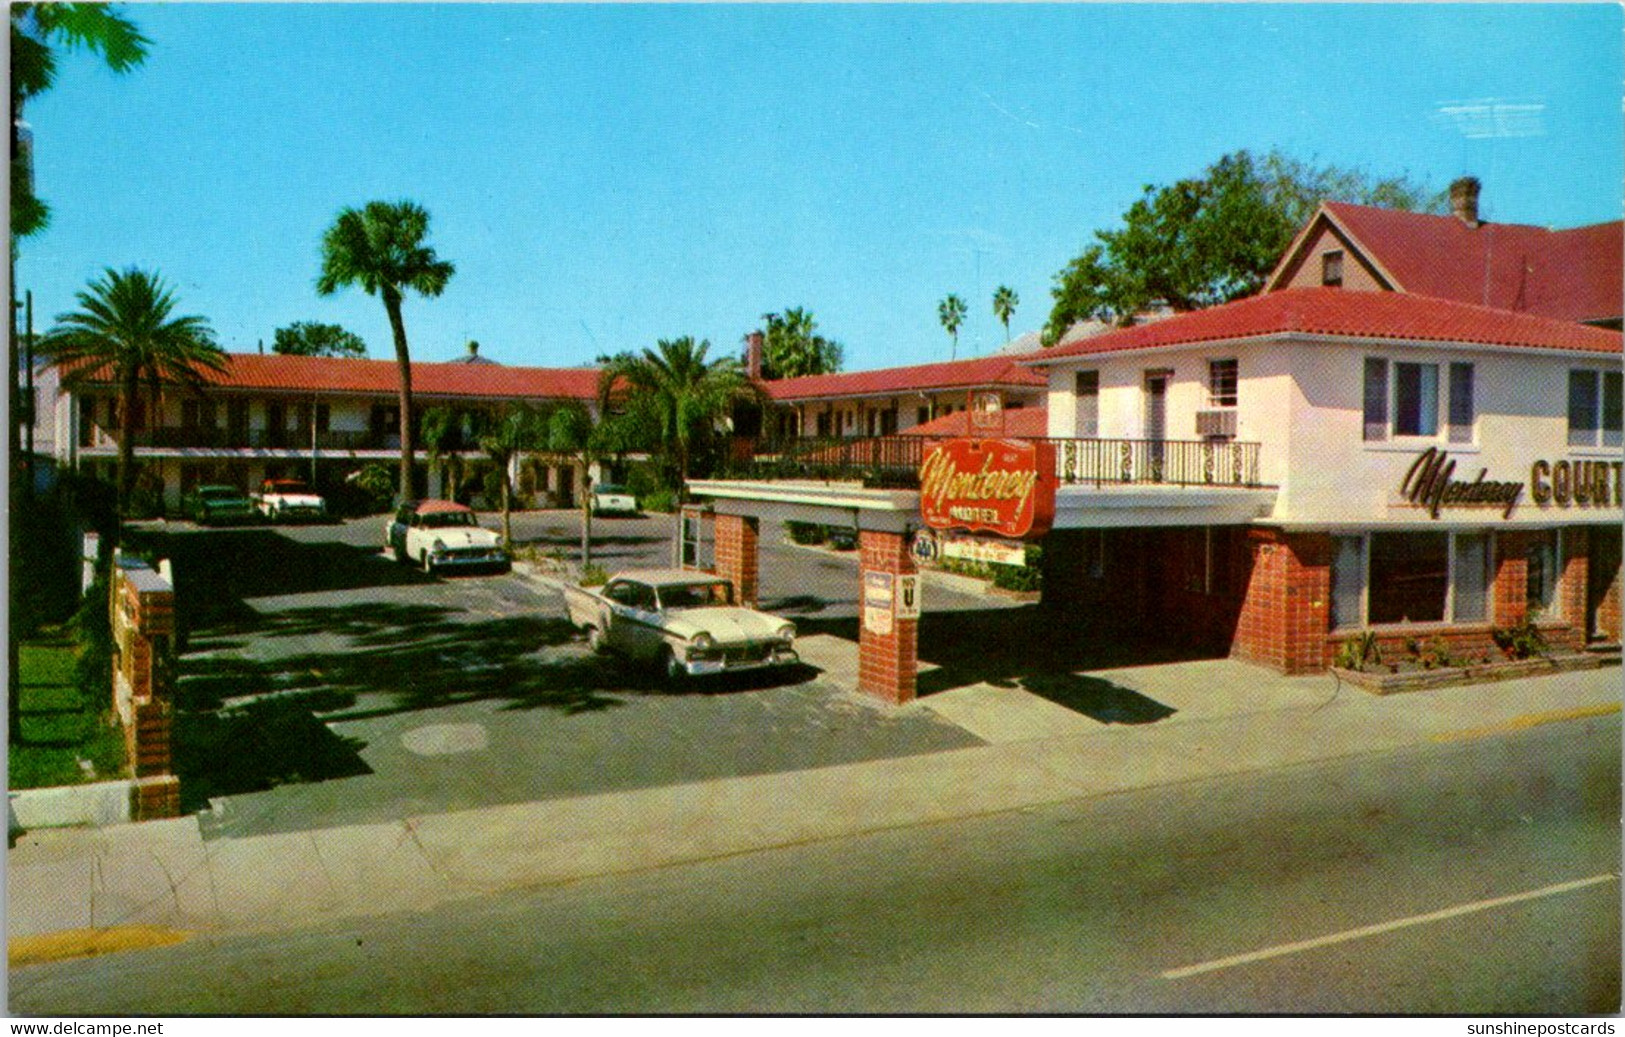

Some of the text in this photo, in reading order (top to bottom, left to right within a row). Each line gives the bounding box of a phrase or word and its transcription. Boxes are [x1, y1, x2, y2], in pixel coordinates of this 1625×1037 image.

[920, 447, 1037, 520] Monterey
[1401, 447, 1623, 519] Monterey COURT
[950, 505, 1000, 524] MOTEL
[904, 588, 914, 607] U
